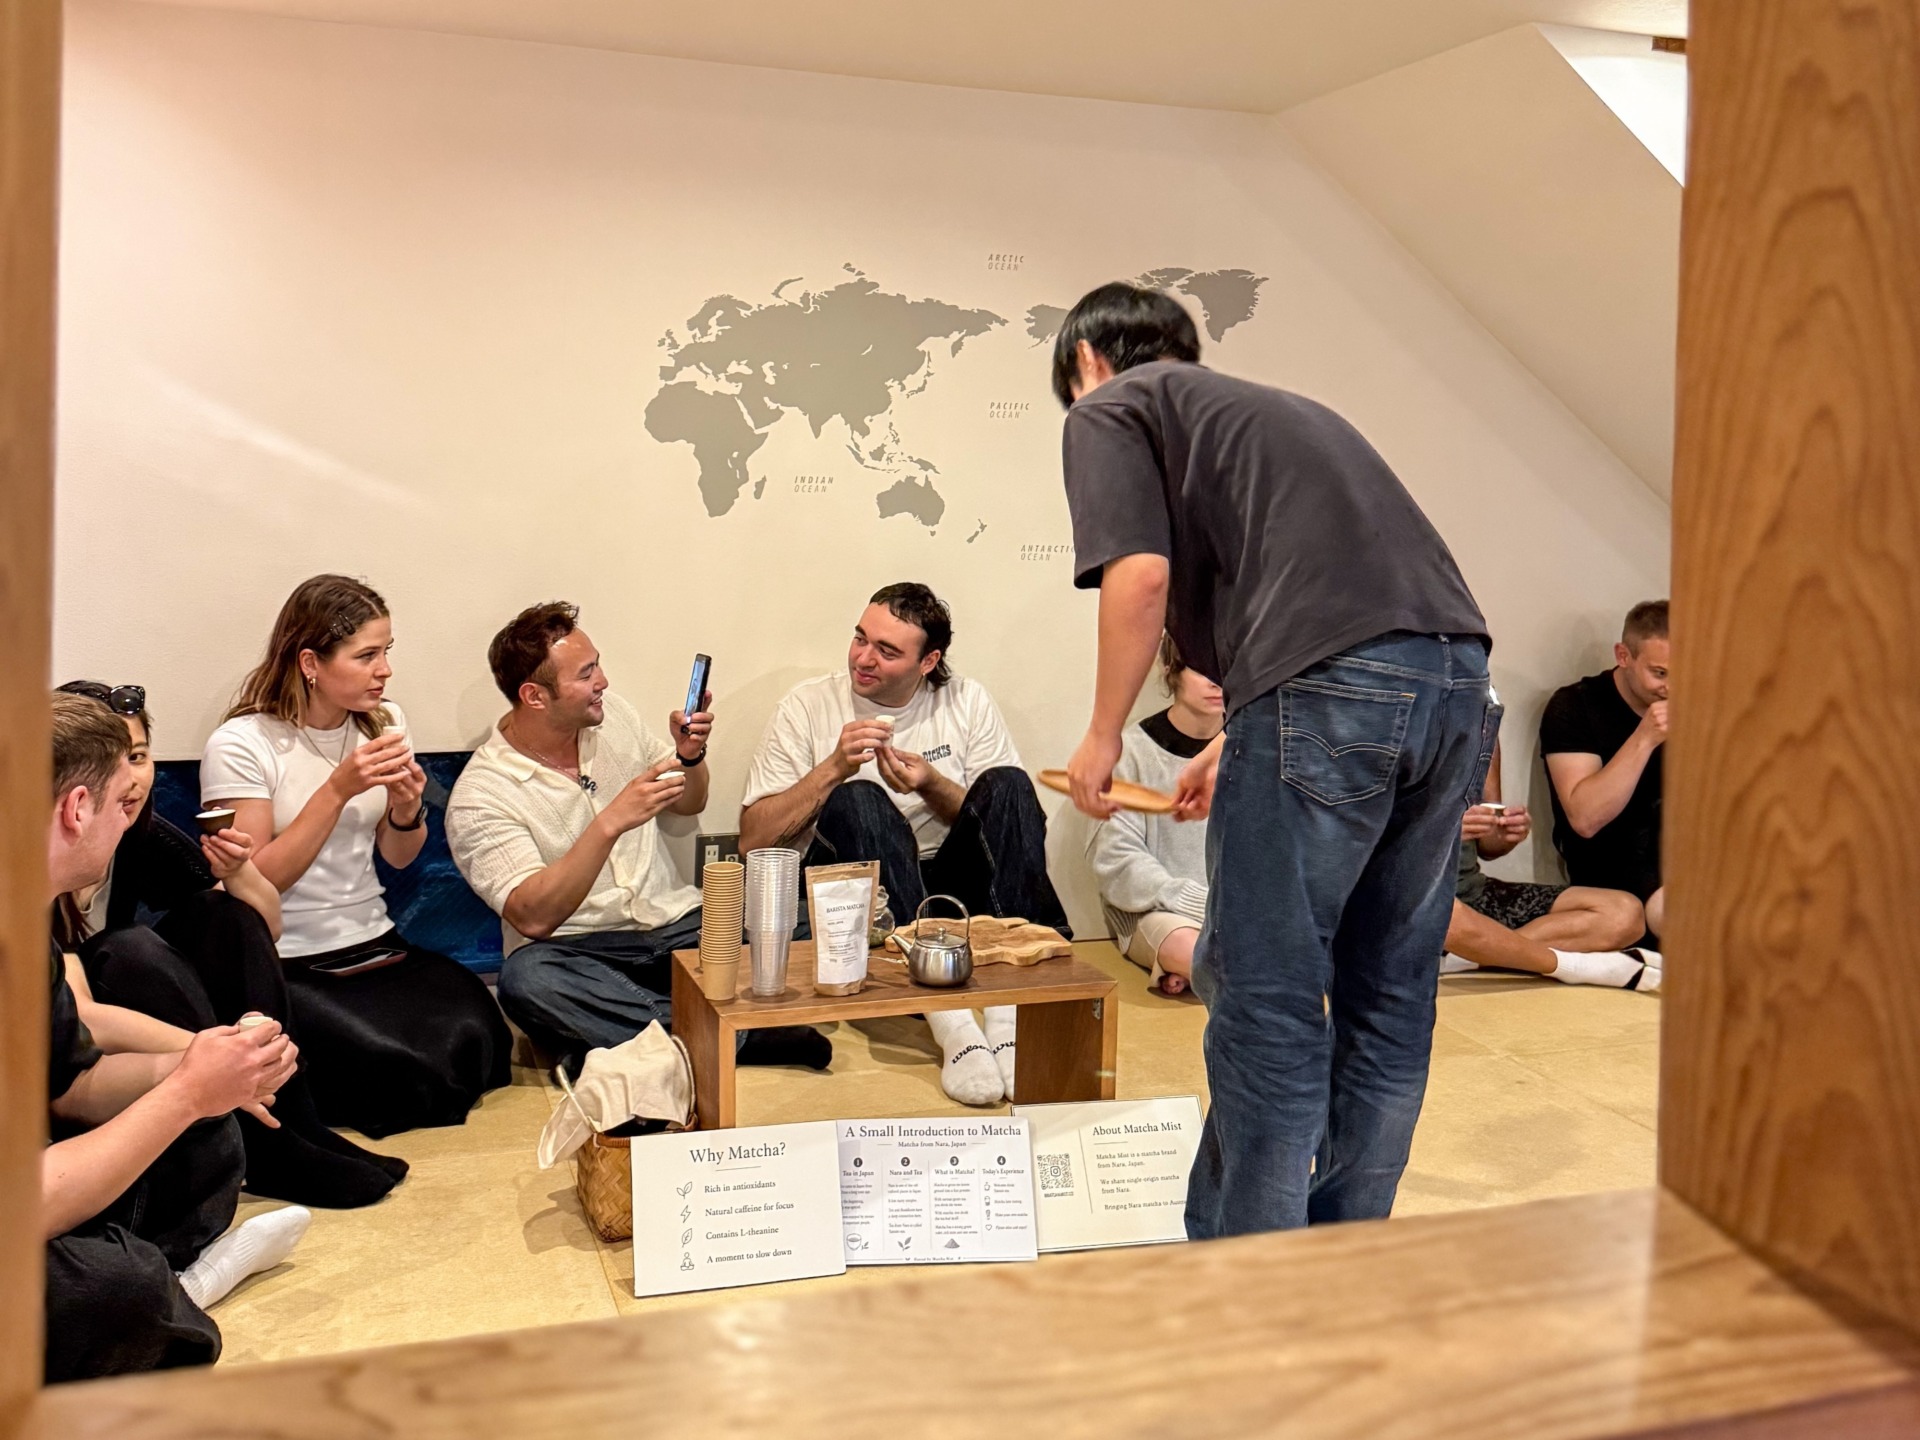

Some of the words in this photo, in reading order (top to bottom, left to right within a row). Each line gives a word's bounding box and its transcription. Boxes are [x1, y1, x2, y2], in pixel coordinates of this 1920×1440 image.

[988, 254, 1024, 263] ARCTIC
[988, 262, 1018, 271] OCEAN
[990, 402, 1030, 410] PACIFIC
[990, 410, 1020, 418] OCEAN
[794, 476, 834, 484] INDIAN
[794, 484, 827, 493] OCEAN
[826, 905, 846, 913] BARISTA
[845, 1126, 855, 1137] A
[859, 1125, 894, 1137] Small
[898, 1125, 965, 1137] Introduction
[967, 1127, 978, 1136] to
[981, 1124, 1021, 1136] Matcha
[1092, 1126, 1121, 1136] About
[1124, 1122, 1158, 1134] Matcha
[1161, 1122, 1182, 1131] Mist
[689, 1148, 724, 1165] Why
[728, 1142, 786, 1160] Matcha?
[1126, 1175, 1159, 1184] single-origin
[704, 1185, 721, 1193] Rich
[733, 1181, 776, 1191] antioxidants
[705, 1206, 733, 1216] Natural
[735, 1204, 762, 1214] caffeine
[776, 1202, 794, 1210] focus
[706, 1230, 738, 1240] Contains
[740, 1226, 779, 1237] L-theanine
[715, 1253, 744, 1262] moment
